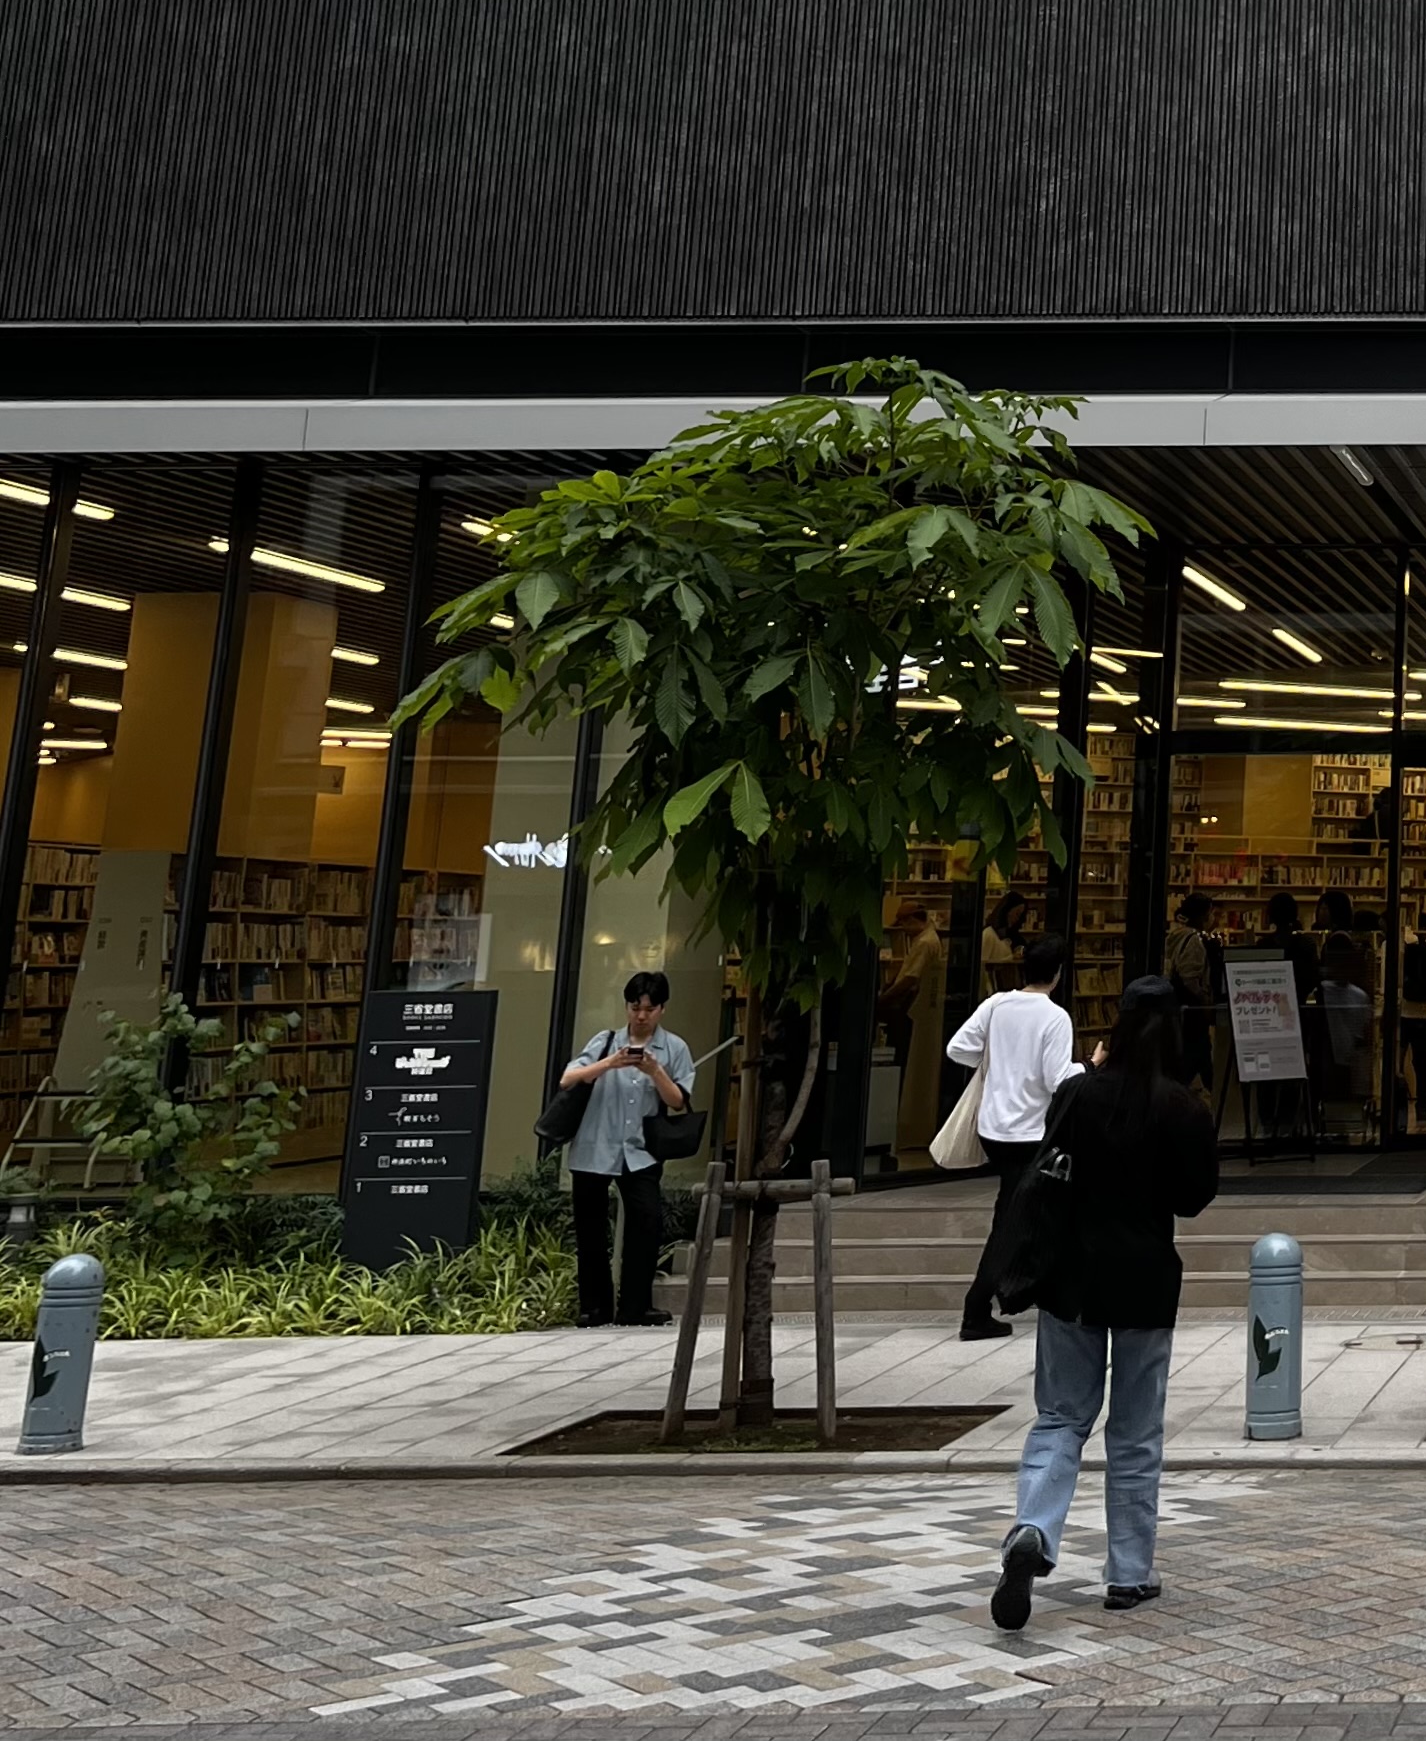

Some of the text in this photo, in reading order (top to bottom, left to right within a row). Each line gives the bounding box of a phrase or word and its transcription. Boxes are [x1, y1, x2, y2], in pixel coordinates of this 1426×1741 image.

[369, 1045, 378, 1056] 4
[364, 1089, 373, 1101] 3
[359, 1135, 369, 1147] 2
[355, 1181, 362, 1193] 1
